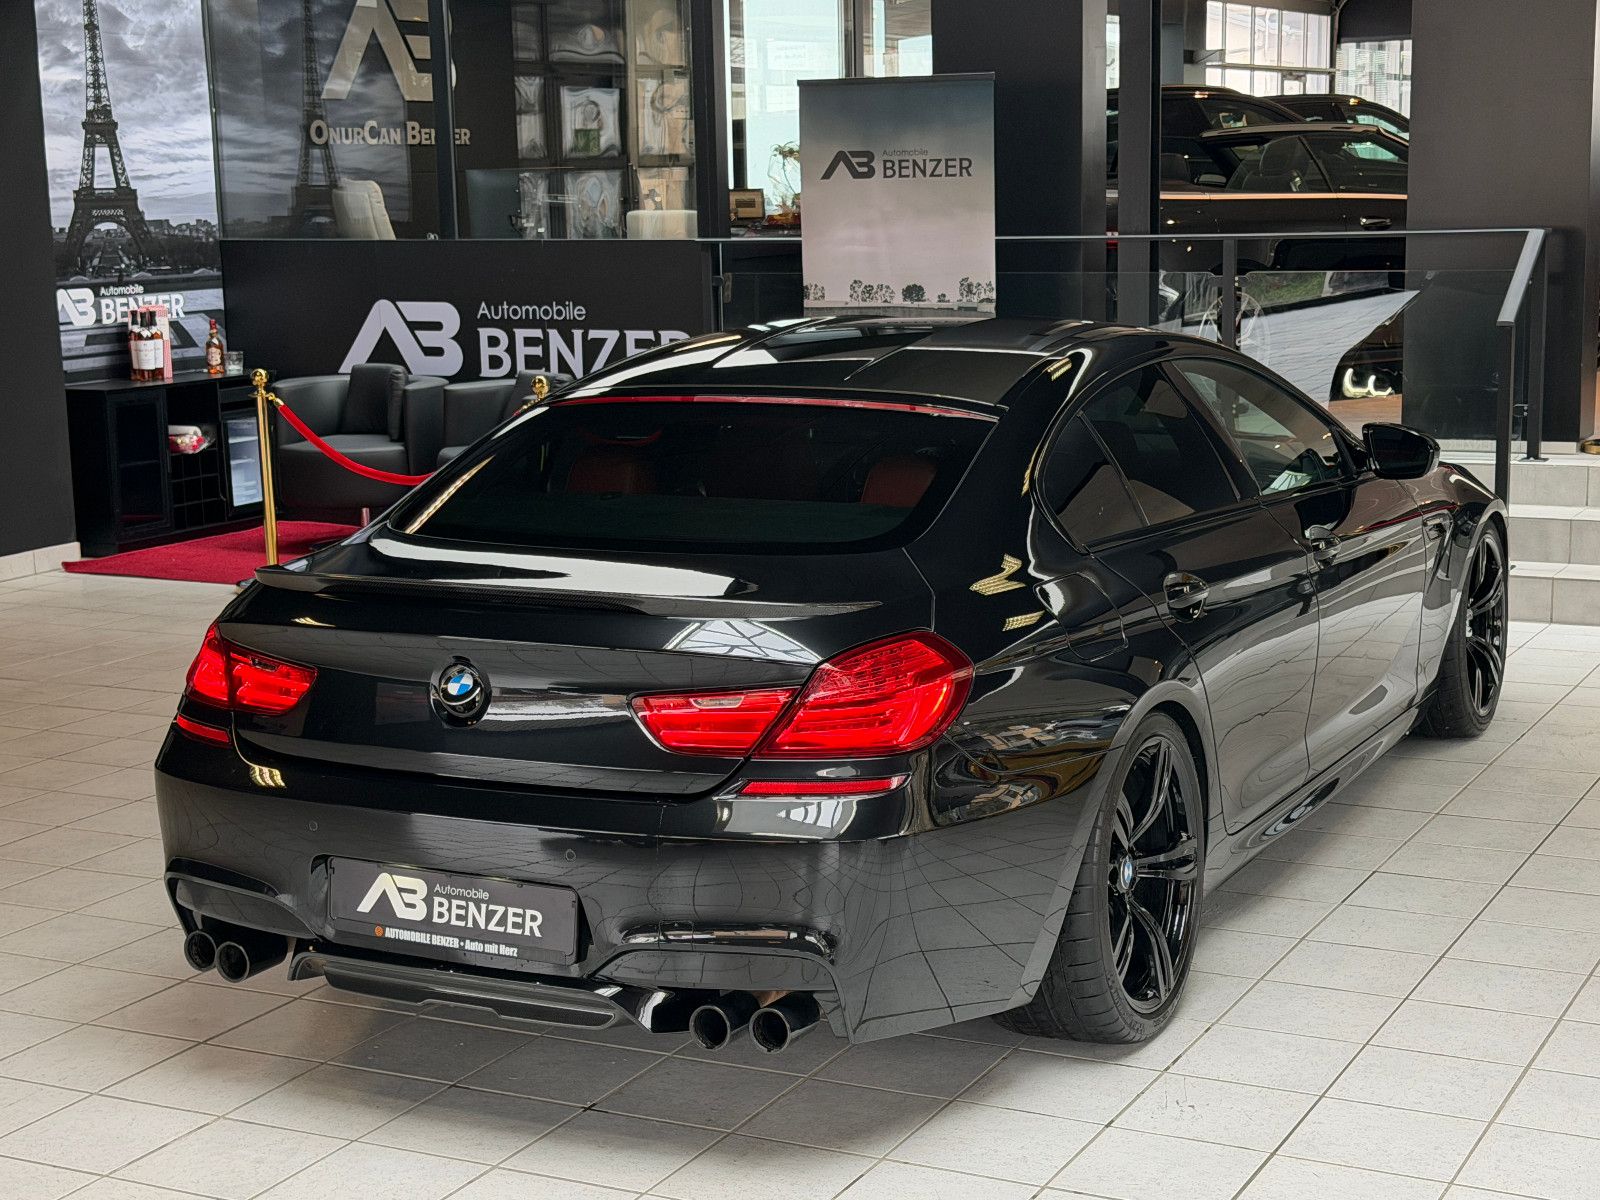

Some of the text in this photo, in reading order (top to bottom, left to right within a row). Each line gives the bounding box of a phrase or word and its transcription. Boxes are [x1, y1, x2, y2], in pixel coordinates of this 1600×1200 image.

[882, 149, 928, 157] Automobile
[882, 157, 973, 179] BENZER
[100, 284, 145, 297] Automobile
[477, 301, 587, 321] Automobile
[434, 883, 490, 901] Automobile
[432, 896, 543, 938] BENZER
[384, 927, 519, 957] AUTOMOBILE BENZER Auto mit Herz
